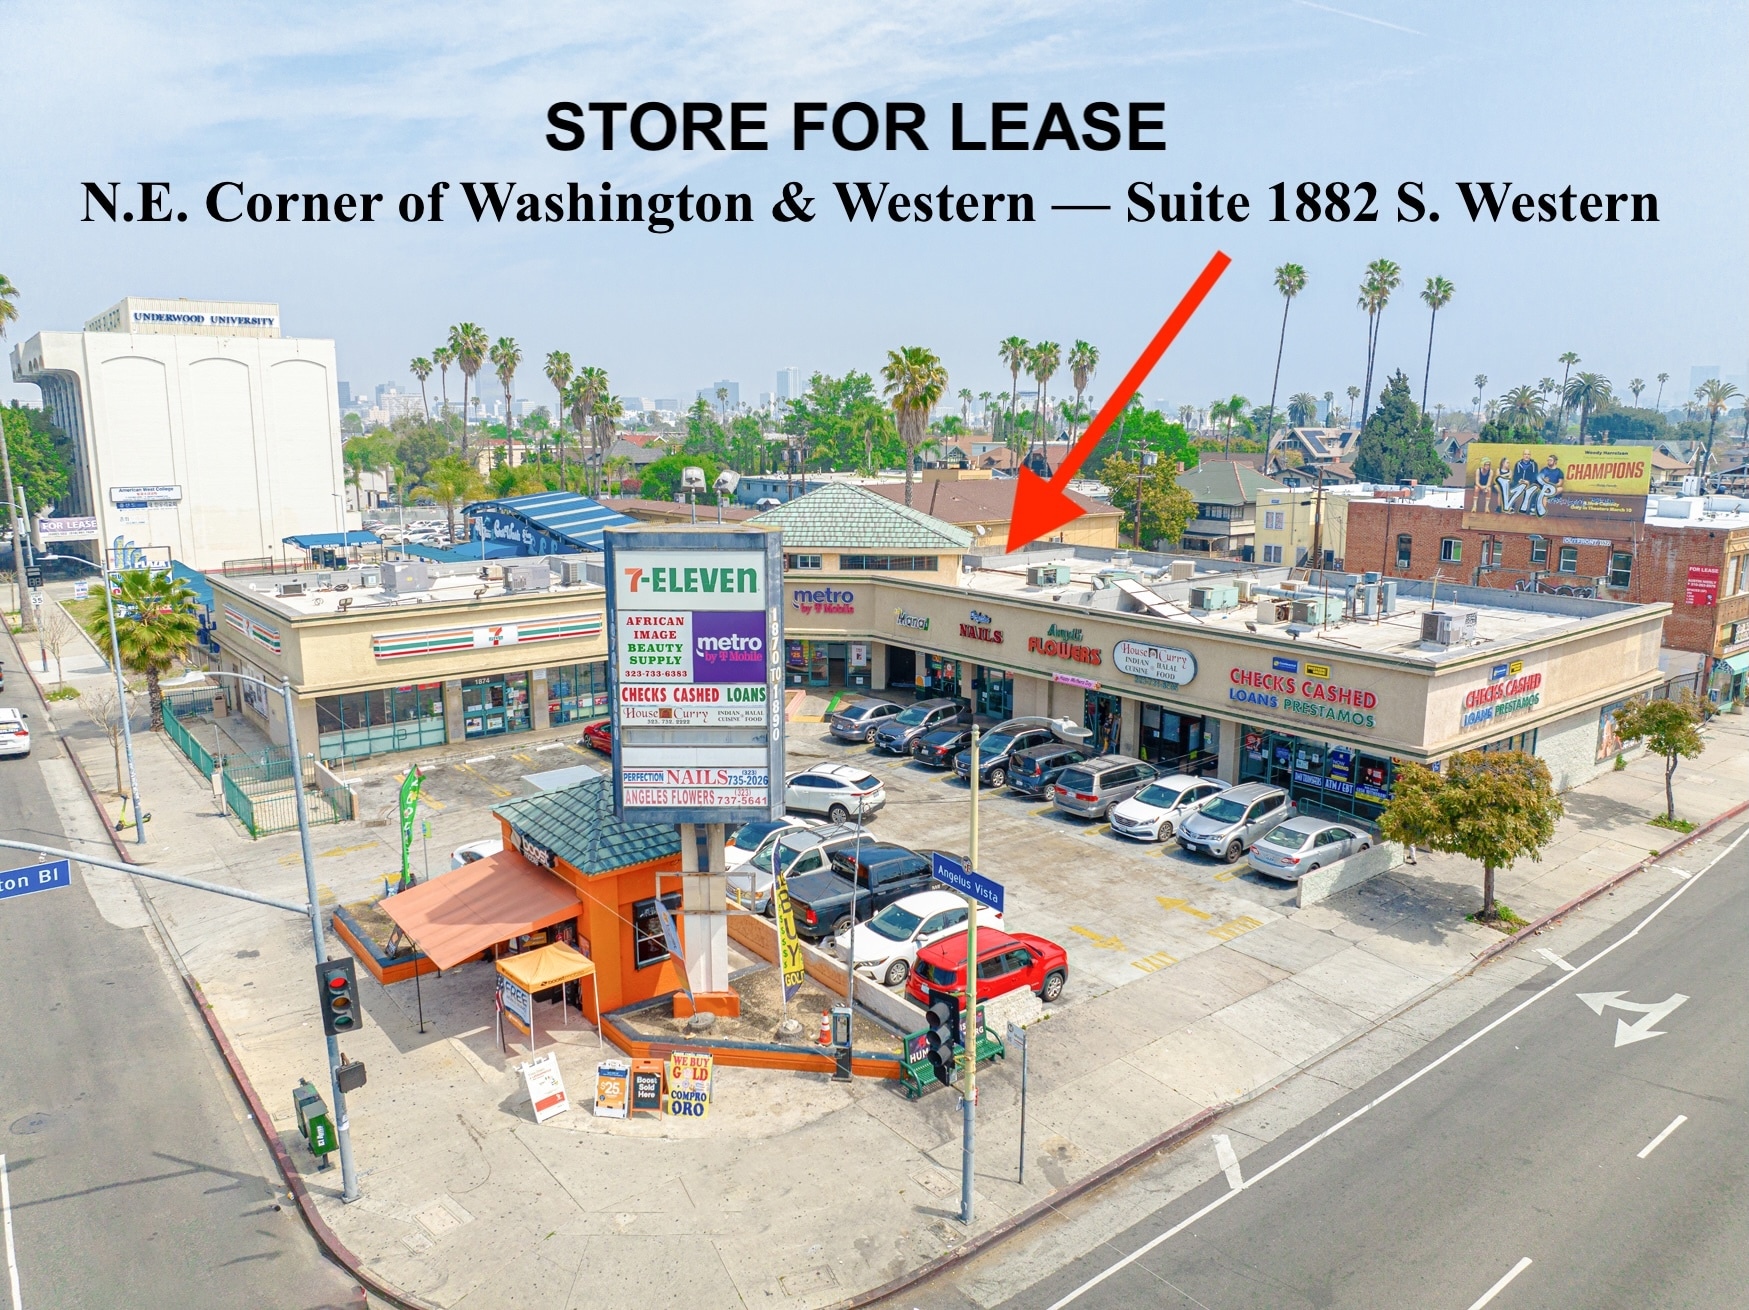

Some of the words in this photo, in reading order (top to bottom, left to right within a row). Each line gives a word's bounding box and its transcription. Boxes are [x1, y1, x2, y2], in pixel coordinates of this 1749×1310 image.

[134, 312, 205, 323] UNDERWOOD
[210, 315, 275, 326] UNIVERSITY
[1566, 461, 1645, 480] CHAMPIONS
[41, 521, 64, 531] FOR
[66, 519, 98, 529] LEASE
[794, 587, 854, 603] metro
[800, 603, 812, 615] by
[823, 603, 855, 614] Mobile
[626, 617, 685, 626] AFRICAN
[633, 630, 677, 639] IMAGE
[959, 623, 1004, 644] NAILS
[627, 643, 684, 653] BEAUTY
[697, 633, 763, 651] metro
[705, 651, 718, 664] by
[729, 651, 763, 661] Mobile
[1027, 636, 1102, 666] FLOWERS
[1121, 642, 1148, 658] House
[1158, 649, 1187, 670] Curry
[629, 655, 682, 665] SUPPLY
[1125, 656, 1149, 666] INDIAN
[1156, 662, 1178, 672] HALAL
[625, 670, 688, 678] 323-733-6383
[1124, 665, 1148, 675] CUISINE
[1156, 670, 1176, 680] FOOD
[621, 686, 667, 702] CHECKS
[673, 687, 720, 702] CASHED
[727, 687, 767, 702] LOANS
[1230, 667, 1297, 695] CHECKS
[1301, 681, 1378, 709] CASHED
[1465, 682, 1504, 709] CHECKS
[1505, 673, 1542, 697] CASHED
[623, 707, 659, 719] House
[673, 707, 709, 723] Curry
[1229, 687, 1279, 708] LOANS
[1283, 698, 1376, 728] PRESTAMOS
[1463, 706, 1493, 727] LOANS
[1494, 692, 1540, 716] PRESTAMOS
[623, 772, 664, 782] PERFECTION
[666, 769, 729, 785] NAILS
[727, 775, 769, 786] 735-2026
[1324, 778, 1338, 791] ATM
[1342, 782, 1354, 795] EBT
[625, 789, 668, 805] ANGELES
[671, 789, 715, 805] FLOWERS
[734, 788, 752, 797] (323)
[717, 796, 768, 805] 737-5641
[938, 865, 972, 890] Angelus
[974, 882, 998, 904] Vista
[779, 889, 799, 967] BUY
[785, 972, 805, 987] GOLD
[505, 981, 528, 1007] FREE
[673, 1055, 688, 1066] WE
[690, 1056, 710, 1068] BUY
[600, 1080, 620, 1095] $25
[636, 1076, 658, 1084] Boost
[638, 1083, 655, 1091] Sold
[670, 1090, 707, 1102] COMPRO
[671, 1100, 705, 1117] ORO
